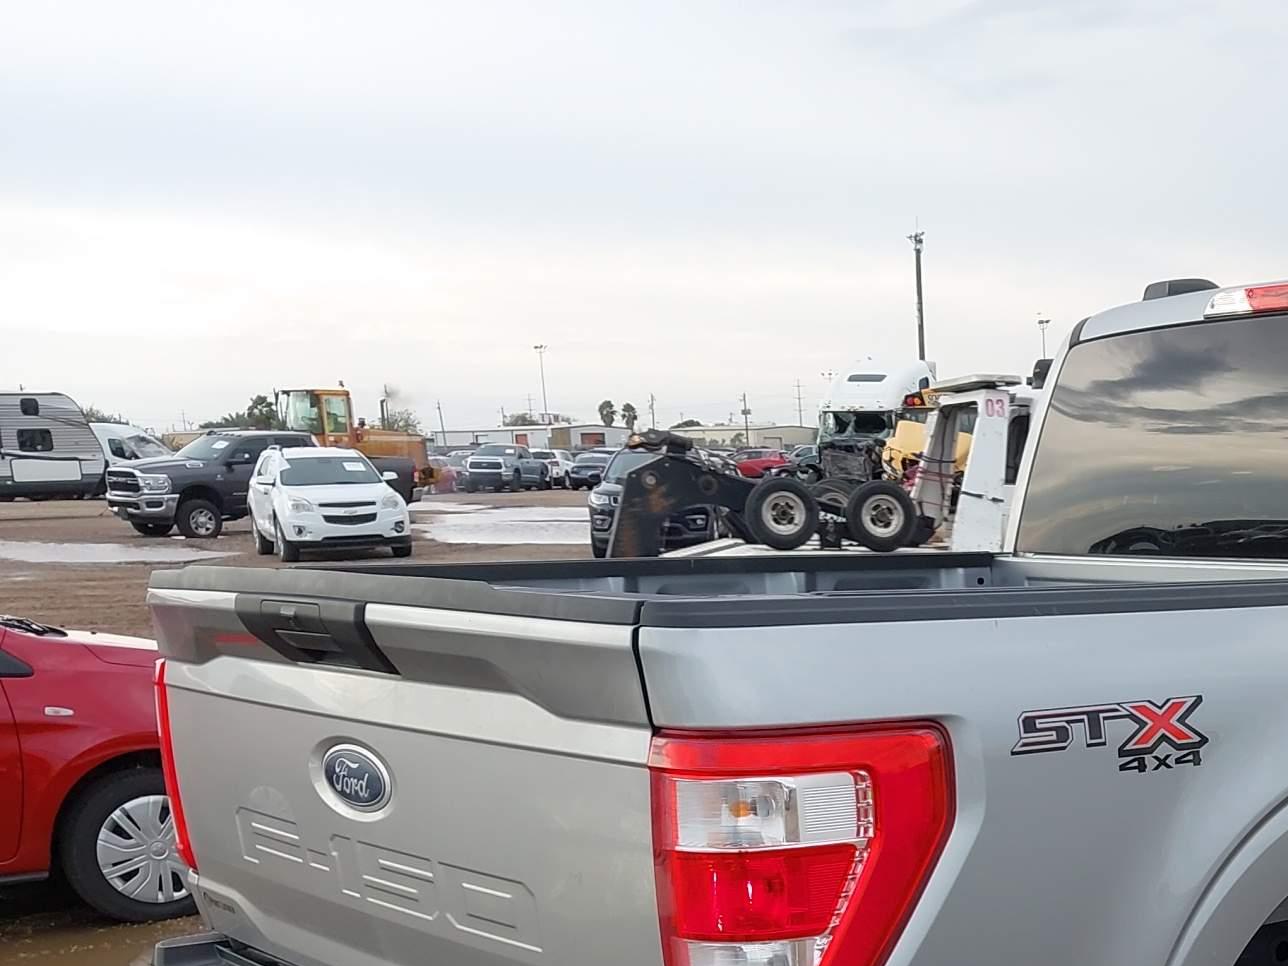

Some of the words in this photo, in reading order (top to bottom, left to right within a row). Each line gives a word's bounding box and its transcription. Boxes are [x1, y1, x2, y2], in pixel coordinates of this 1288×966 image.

[984, 397, 1006, 418] 03
[1010, 694, 1209, 758] STX
[332, 757, 370, 798] Ford
[234, 806, 544, 953] F-150
